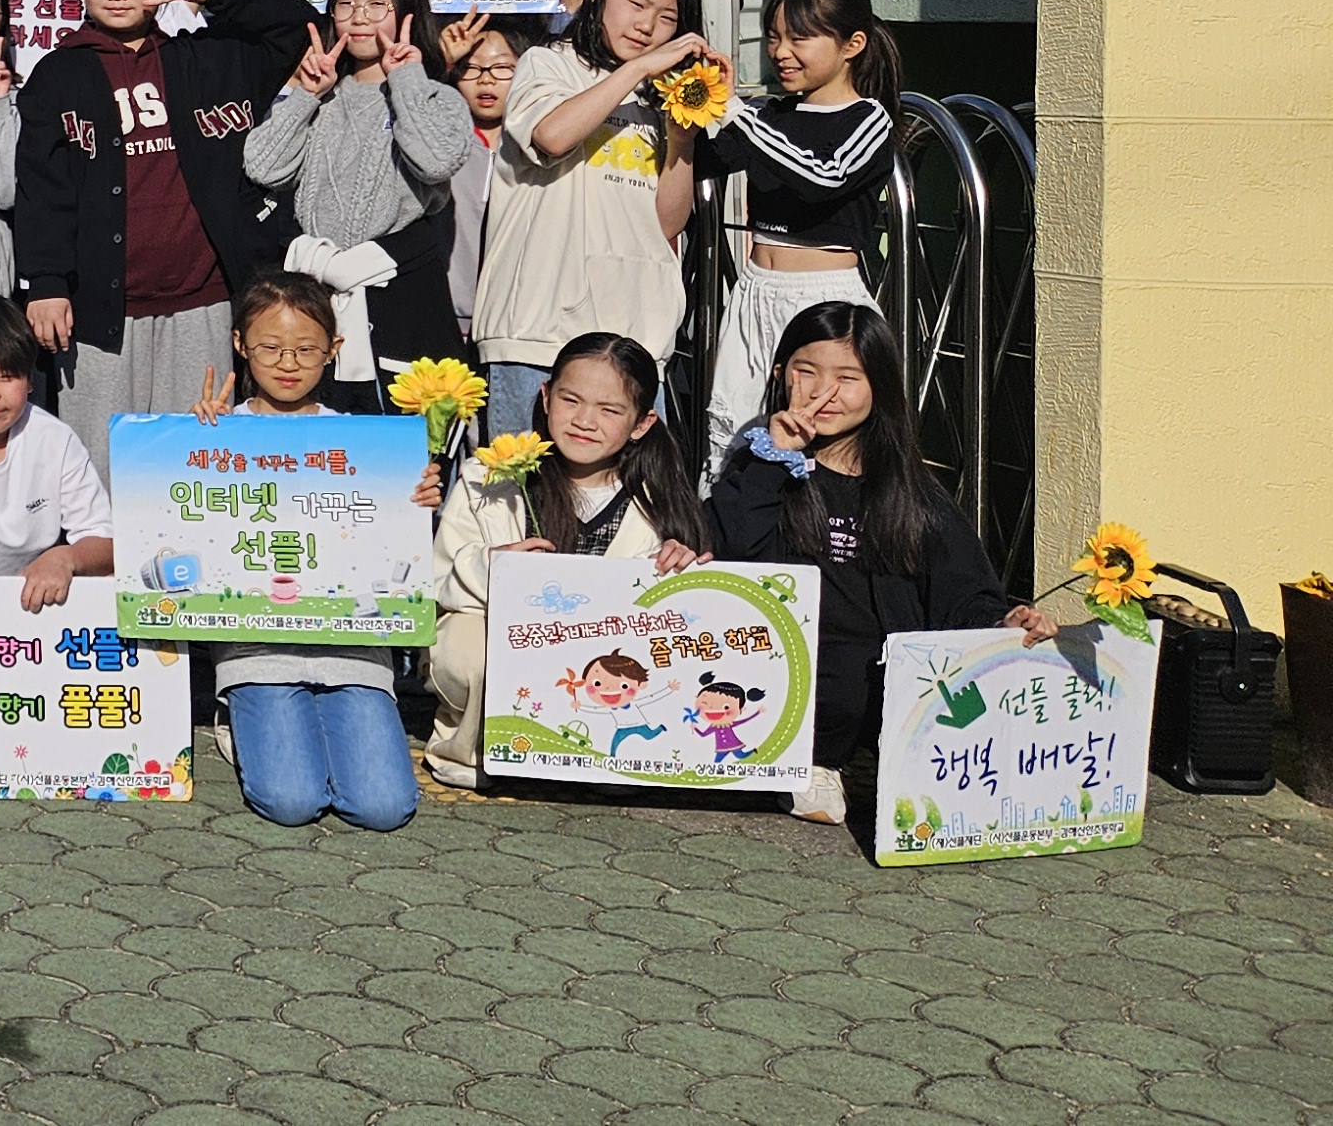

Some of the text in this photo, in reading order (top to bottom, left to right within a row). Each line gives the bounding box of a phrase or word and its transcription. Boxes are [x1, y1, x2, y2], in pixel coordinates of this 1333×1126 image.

[186, 448, 357, 476] 세상을 가꾸는 피플,
[170, 481, 377, 523] 인터넷 가꾸는
[231, 530, 318, 573] 선플!
[178, 613, 238, 627] (재)선플재단
[333, 617, 414, 631] 김해신안초등학교
[629, 609, 688, 637] 넘치는
[649, 625, 773, 668] 즐거운 학교
[998, 676, 1049, 724] 선플
[532, 754, 593, 768] (재)선플재단
[931, 731, 1116, 796] 행복 배달!
[931, 834, 982, 850] (재)선플재단
[1061, 824, 1125, 840] 김해신안초등학교
